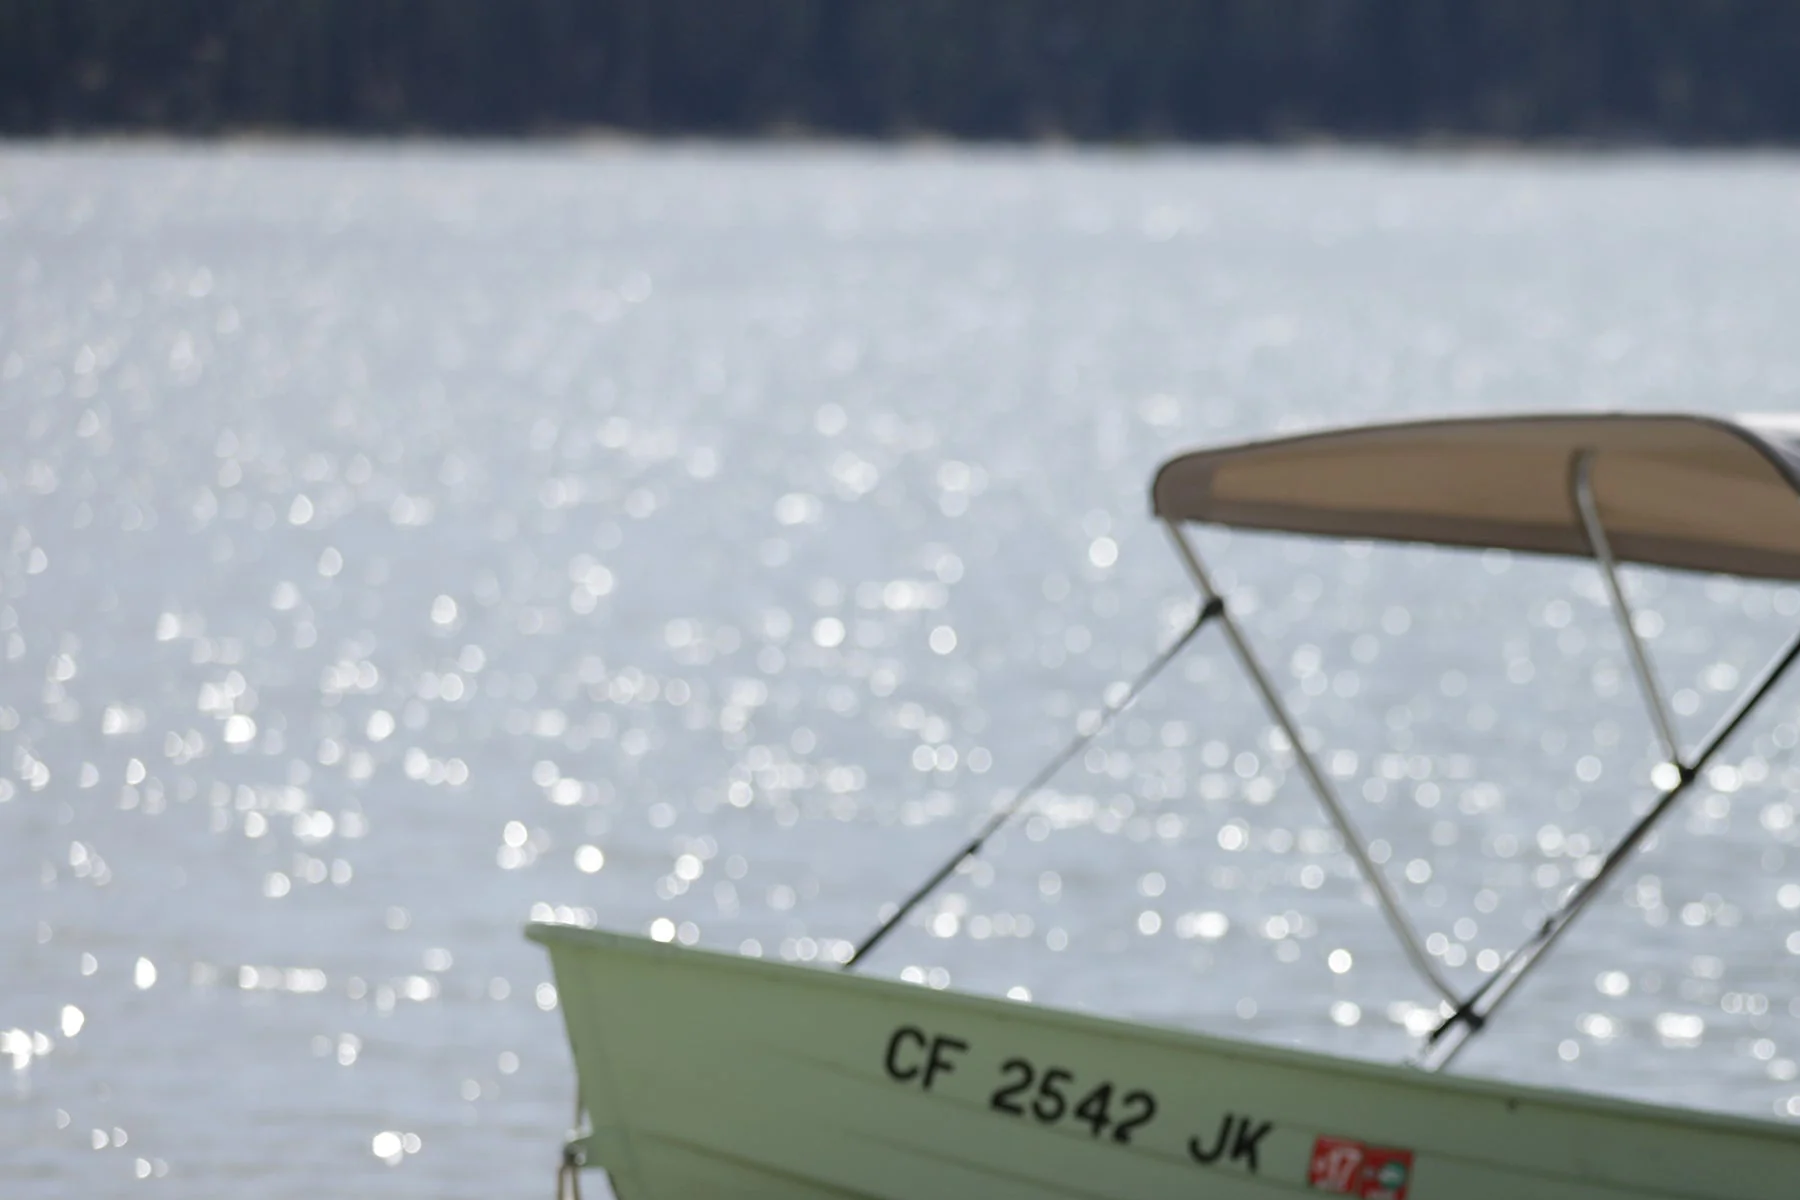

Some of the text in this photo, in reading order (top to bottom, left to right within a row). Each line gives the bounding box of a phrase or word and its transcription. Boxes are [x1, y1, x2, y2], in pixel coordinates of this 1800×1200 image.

[884, 1026, 968, 1090] CF
[989, 1057, 1157, 1146] 2542
[1187, 1113, 1273, 1175] JK
